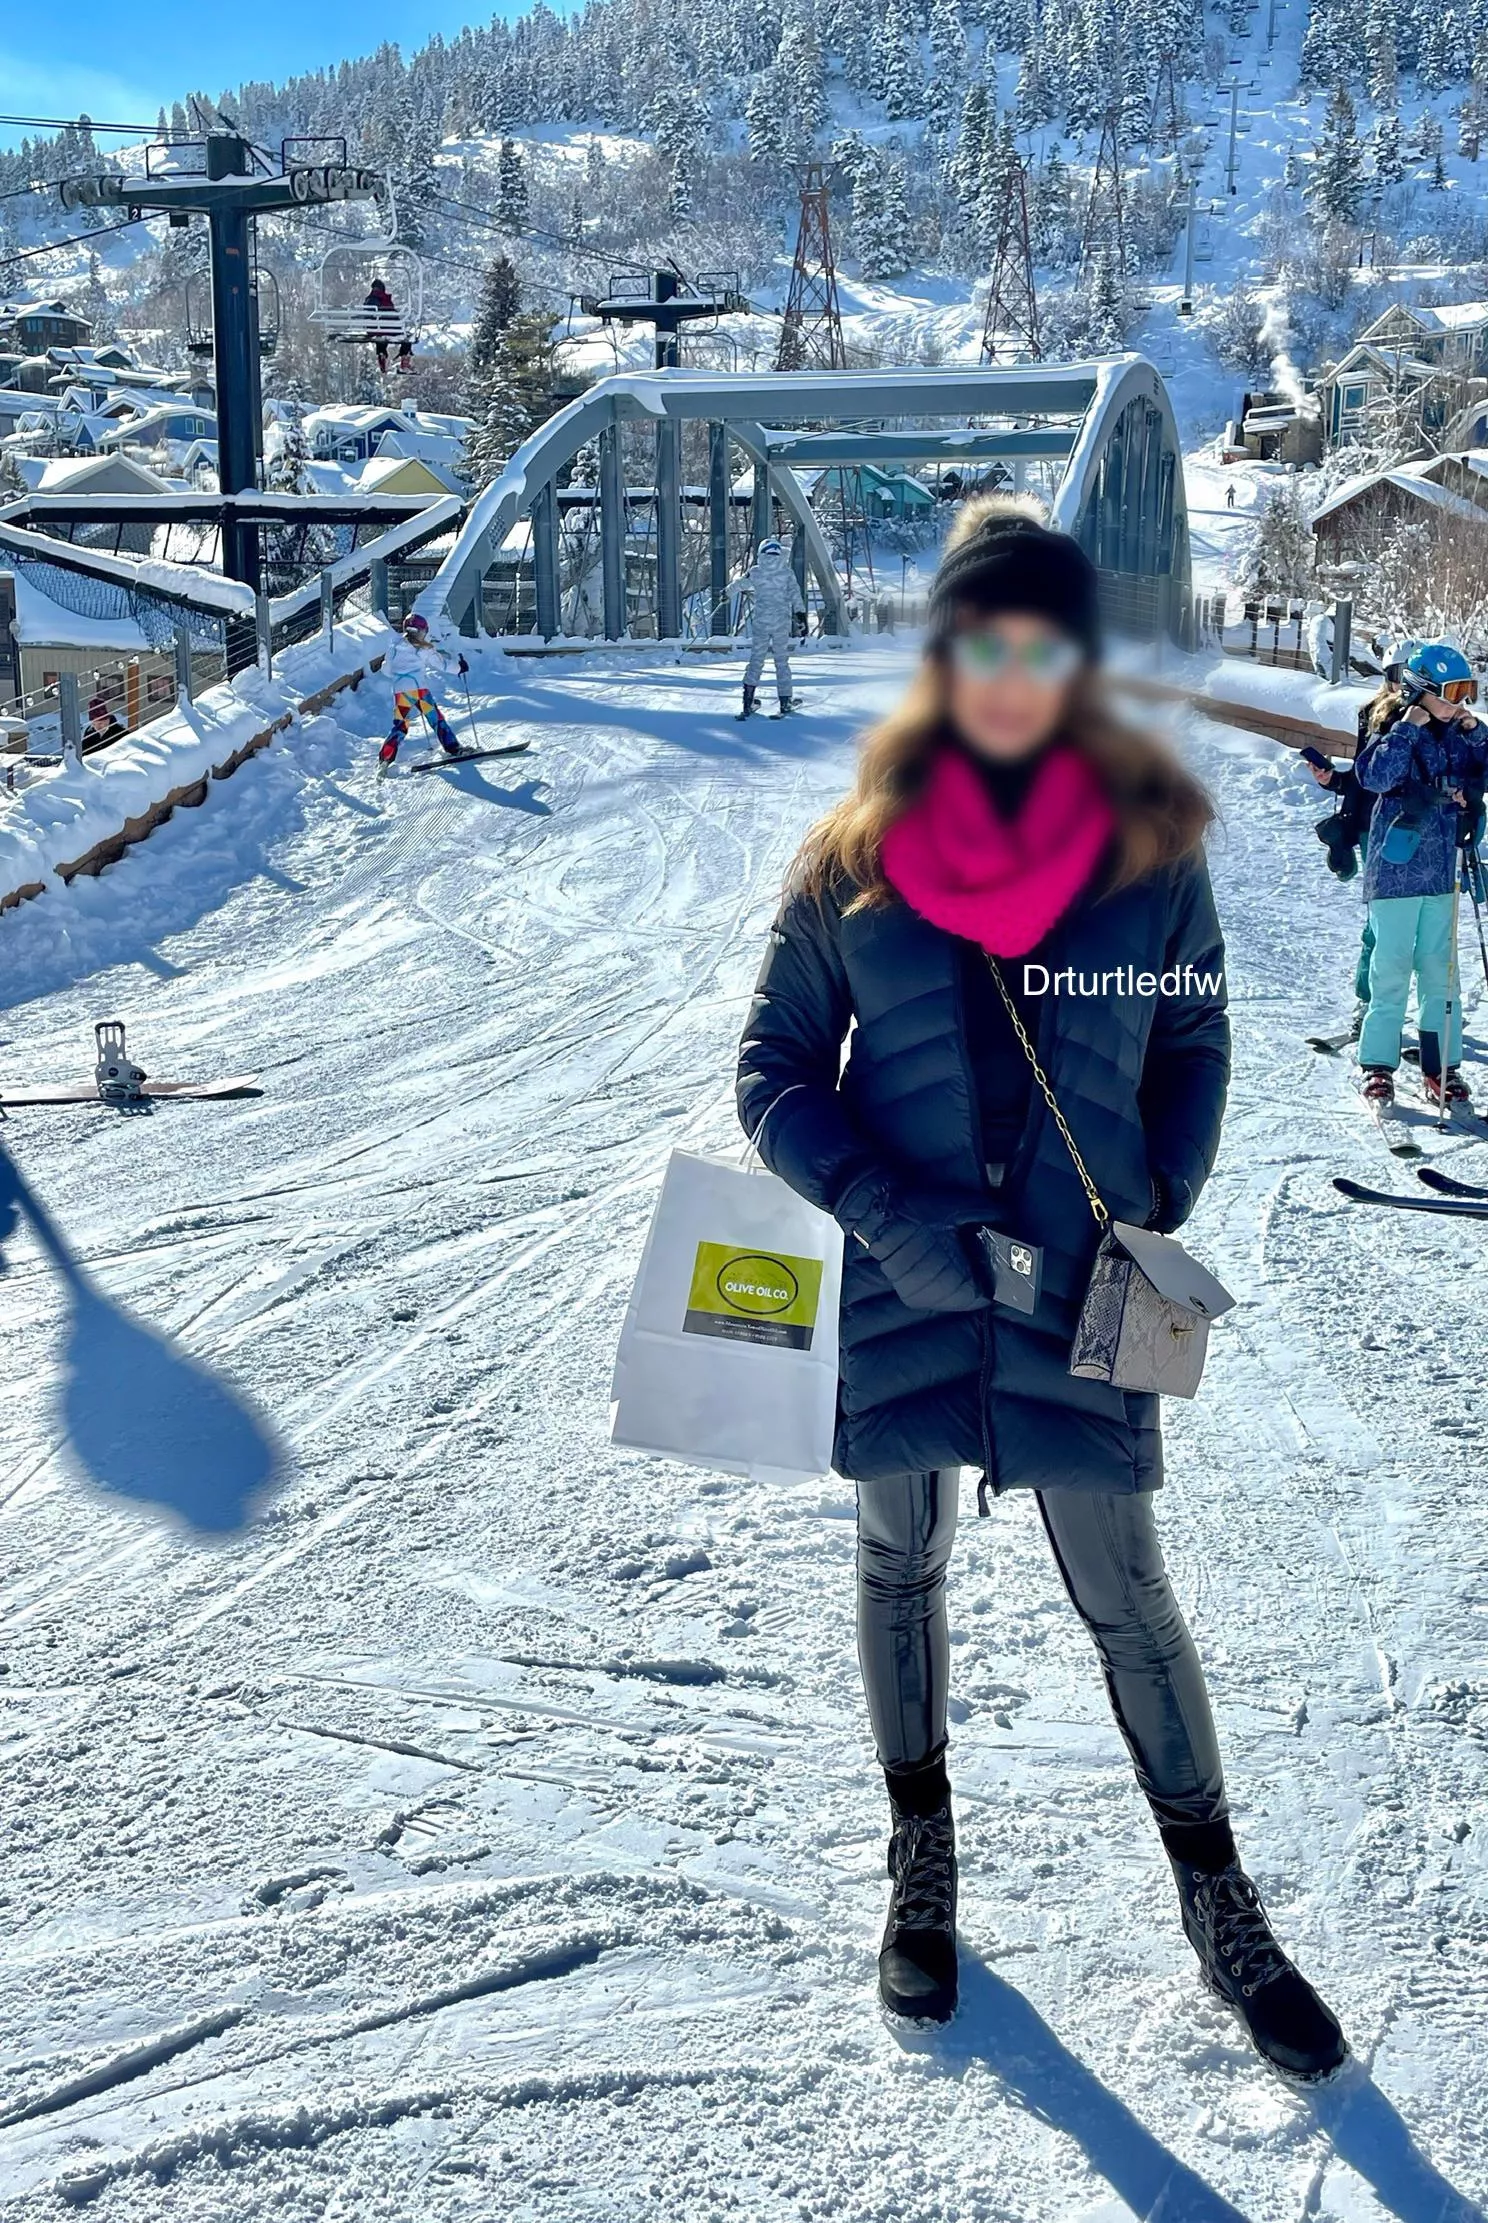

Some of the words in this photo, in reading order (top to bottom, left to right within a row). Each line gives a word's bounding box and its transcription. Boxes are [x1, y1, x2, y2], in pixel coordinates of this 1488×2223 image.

[131, 208, 139, 220] 2
[725, 1282, 755, 1295] OLIVE
[756, 1286, 772, 1298] OIL
[773, 1289, 789, 1301] CO.
